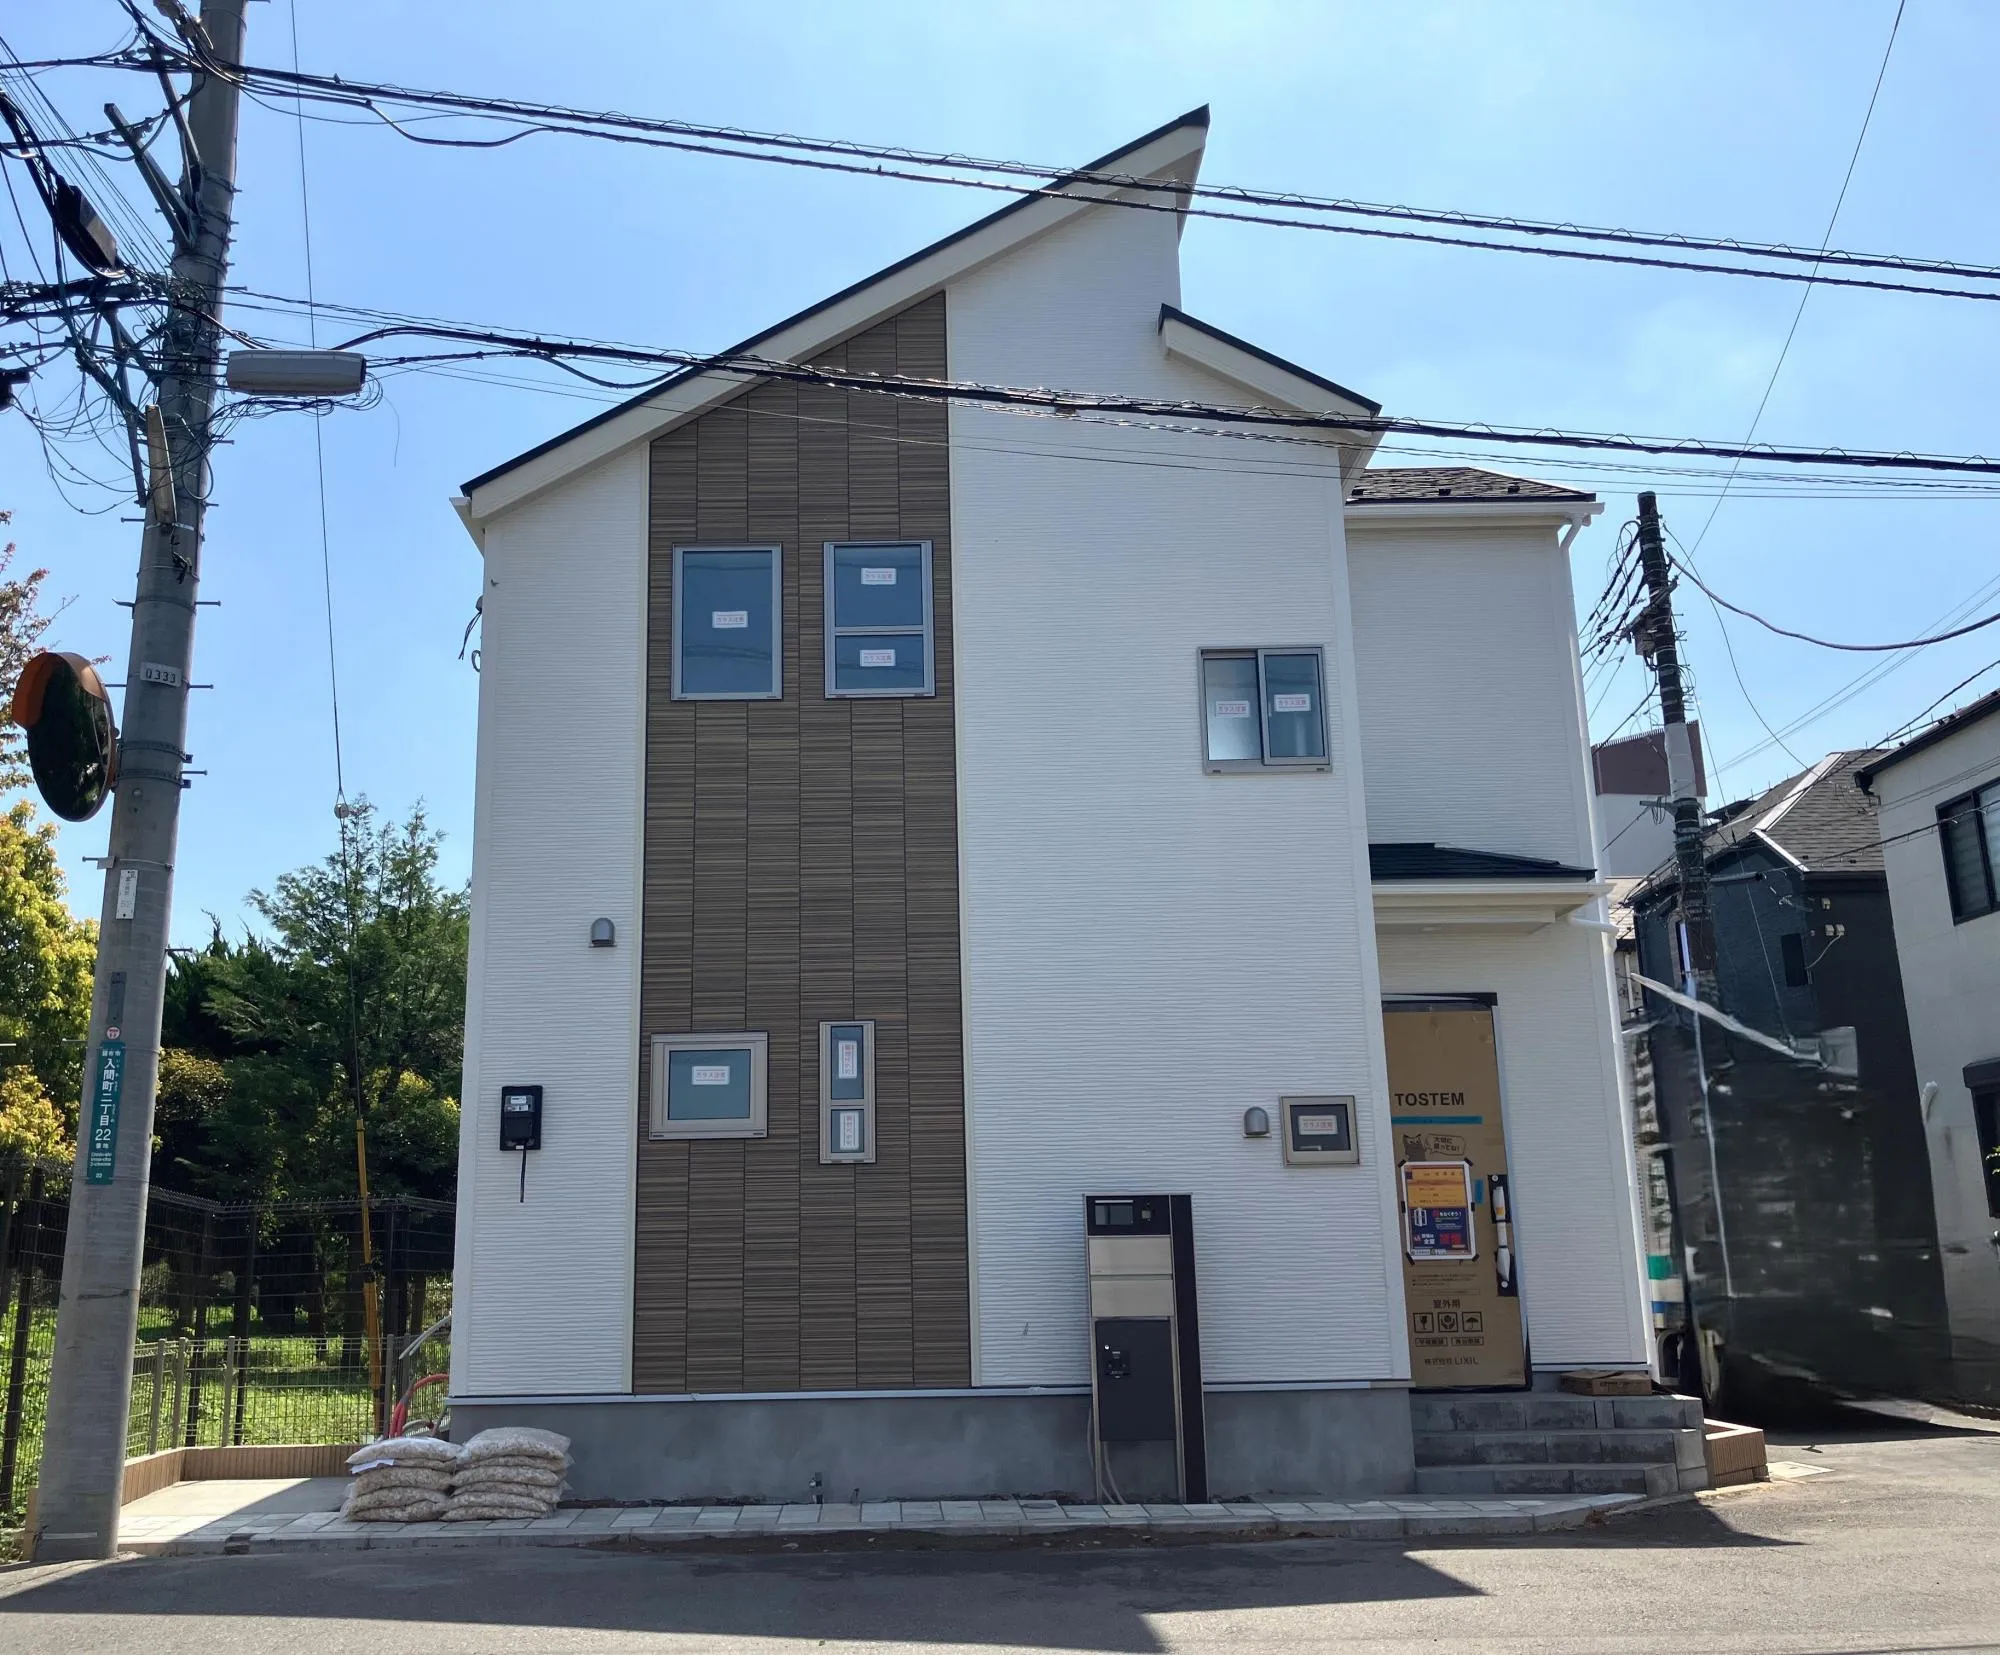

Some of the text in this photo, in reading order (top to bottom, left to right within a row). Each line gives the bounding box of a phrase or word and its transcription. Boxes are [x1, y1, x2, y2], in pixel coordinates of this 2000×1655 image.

[100, 1058, 115, 1126] 入間町二丁目
[1394, 1092, 1465, 1106] TOSTEM
[95, 1128, 111, 1141] 22
